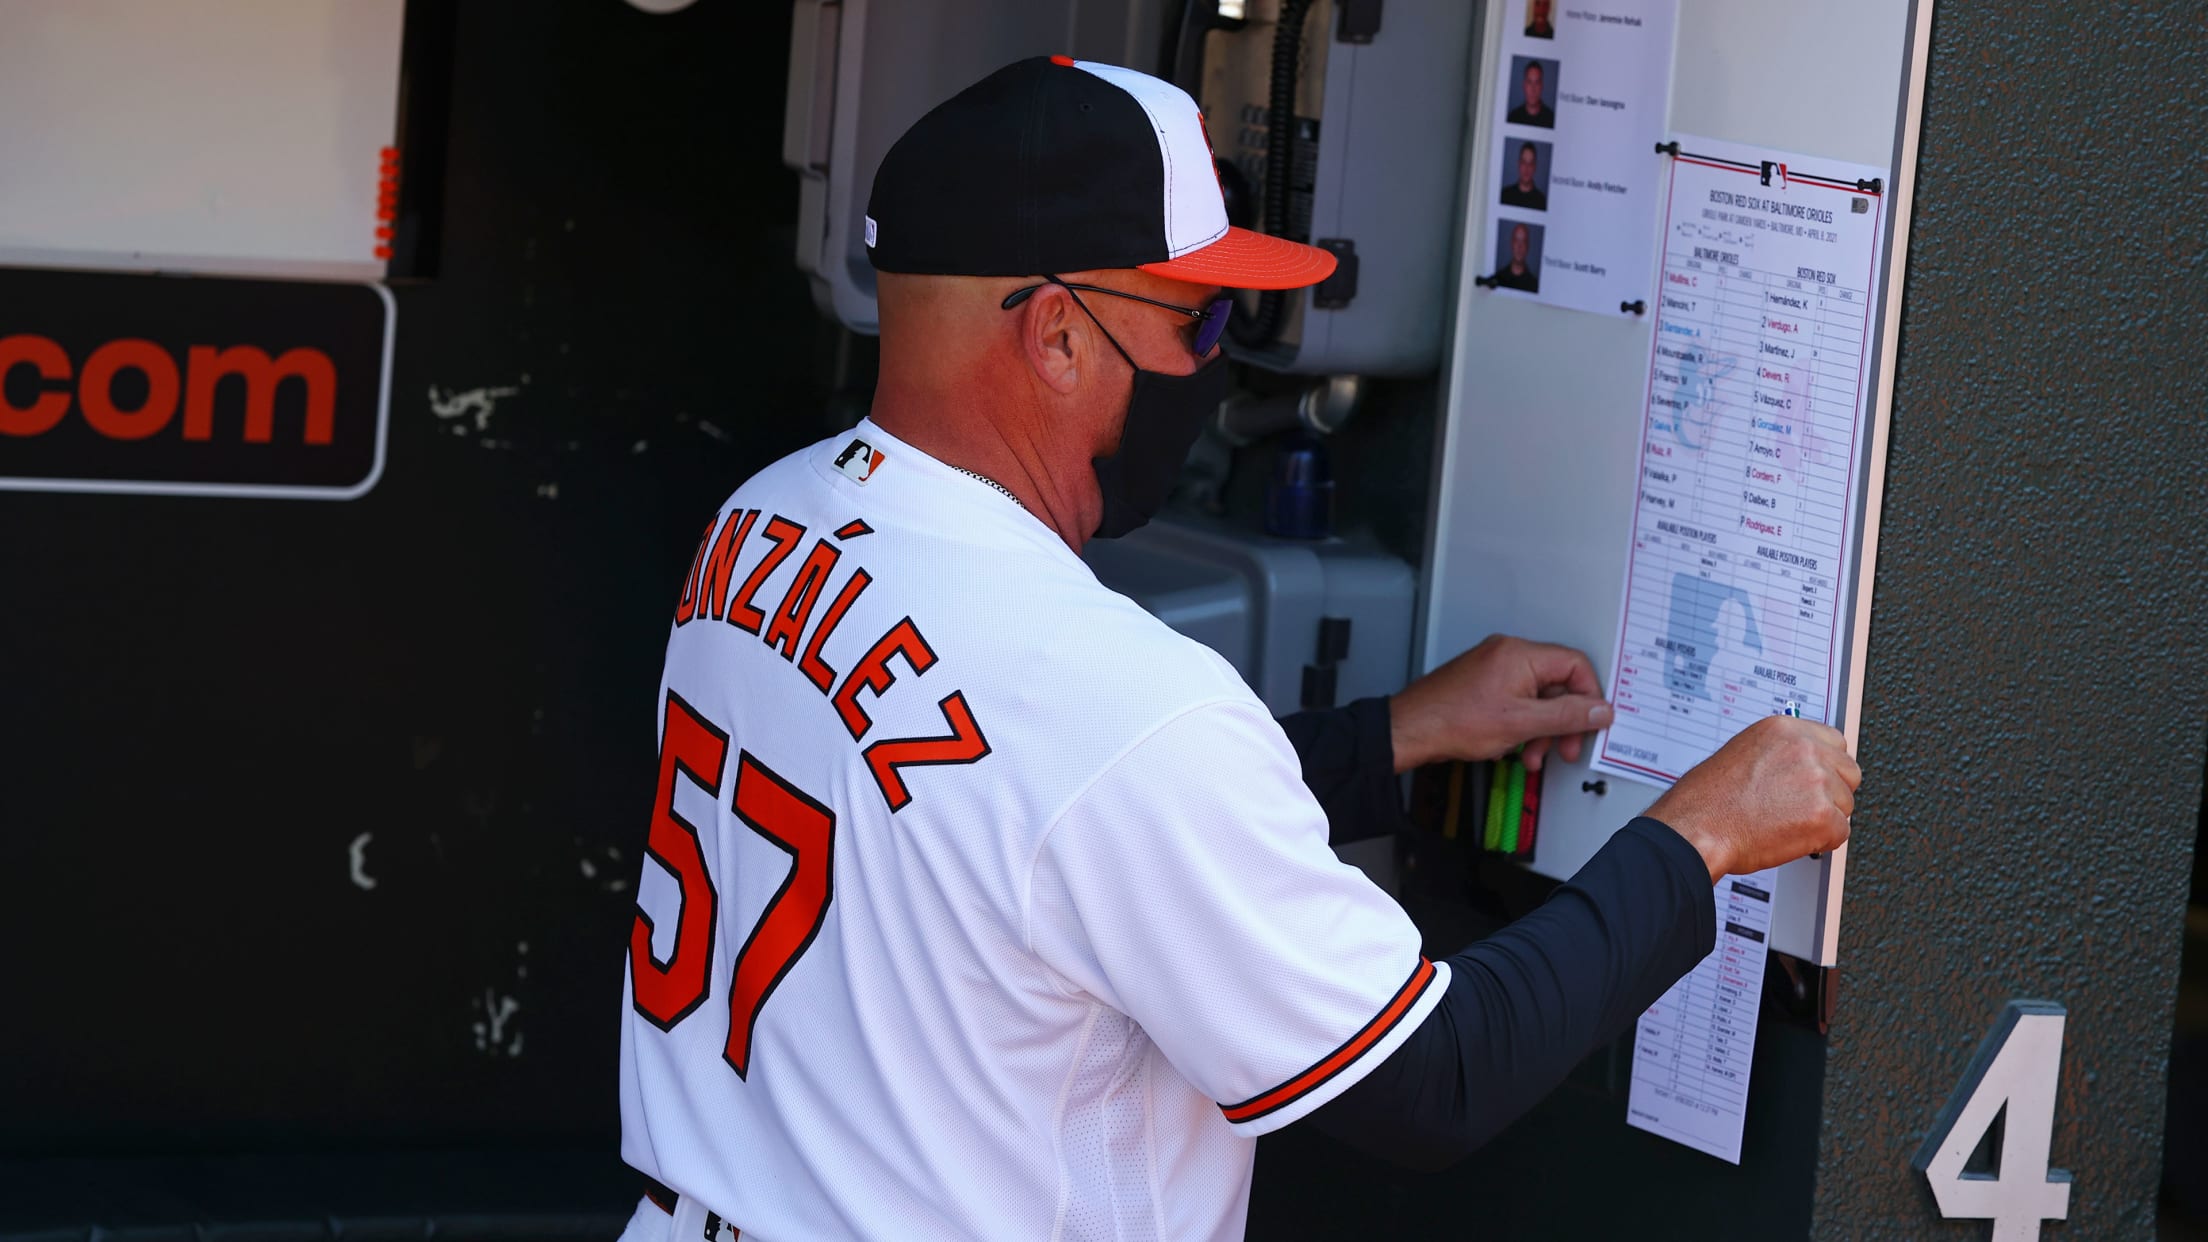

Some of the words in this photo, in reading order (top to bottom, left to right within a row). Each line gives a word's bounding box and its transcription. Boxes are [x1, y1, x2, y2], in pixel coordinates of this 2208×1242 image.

[1710, 190, 1734, 206] BOSTON
[1735, 195, 1747, 208] RED
[1748, 196, 1761, 210] SOX
[1761, 200, 1769, 211] AT
[1771, 200, 1805, 219] BALTIMORE
[1806, 207, 1833, 224] ORIOLES
[1694, 246, 1719, 262] BALTIMORE
[1720, 251, 1739, 266] ORIOLES
[1797, 266, 1815, 280] BOSTON
[1816, 270, 1826, 283] RED
[1826, 272, 1836, 285] SOX
[1802, 299, 1808, 310] K
[1761, 316, 1767, 328] 2
[1793, 323, 1799, 333] A
[1759, 341, 1764, 353] 3
[1790, 349, 1795, 359] J
[1762, 368, 1783, 382] Devers,
[1784, 372, 1790, 383] R
[1753, 390, 1758, 403] 5
[1785, 399, 1791, 409] C
[1785, 424, 1791, 435] M
[1754, 443, 1775, 458] Arroyo,
[1775, 448, 1781, 459] C
[1746, 465, 1751, 478] 8
[1776, 473, 1782, 484] F
[1743, 490, 1748, 503] 9
[1748, 492, 1770, 509] Dalbec,
[1771, 498, 1776, 509] B
[1740, 515, 1745, 528] P
[1776, 526, 1782, 537] E
[1756, 545, 1779, 560] AVAILABLE
[1779, 551, 1800, 565] POSITION
[1799, 555, 1818, 570] PLAYERS
[1753, 665, 1776, 680] AVAILABLE
[1776, 671, 1797, 686] PITCHERS
[629, 687, 836, 1083] 57
[1922, 1004, 2071, 1242] 4
